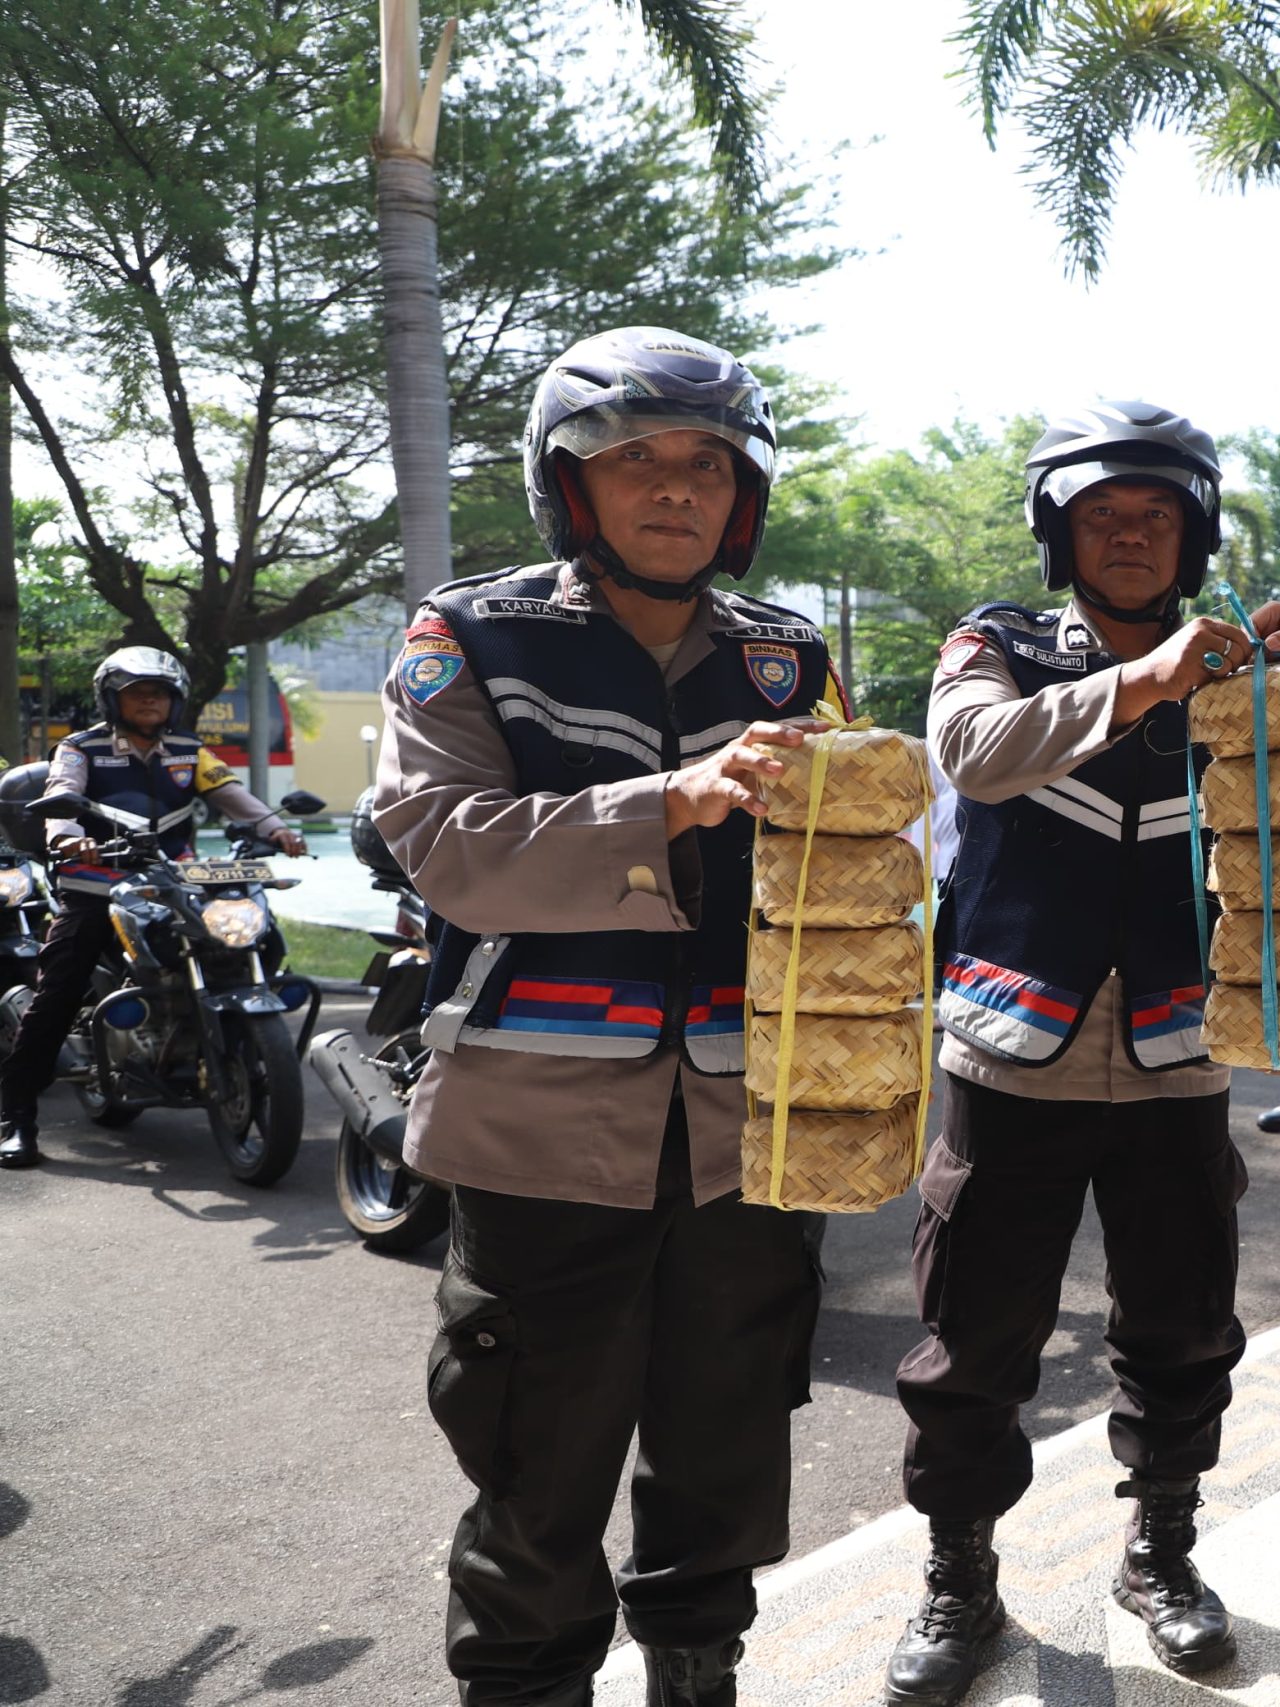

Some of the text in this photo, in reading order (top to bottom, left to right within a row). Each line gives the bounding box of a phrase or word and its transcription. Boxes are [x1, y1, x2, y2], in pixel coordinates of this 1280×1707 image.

[500, 600, 567, 617] KARYADI
[731, 625, 809, 639] OLRI
[748, 645, 792, 657] BINMAS
[1036, 651, 1082, 667] SULISTIANTO
